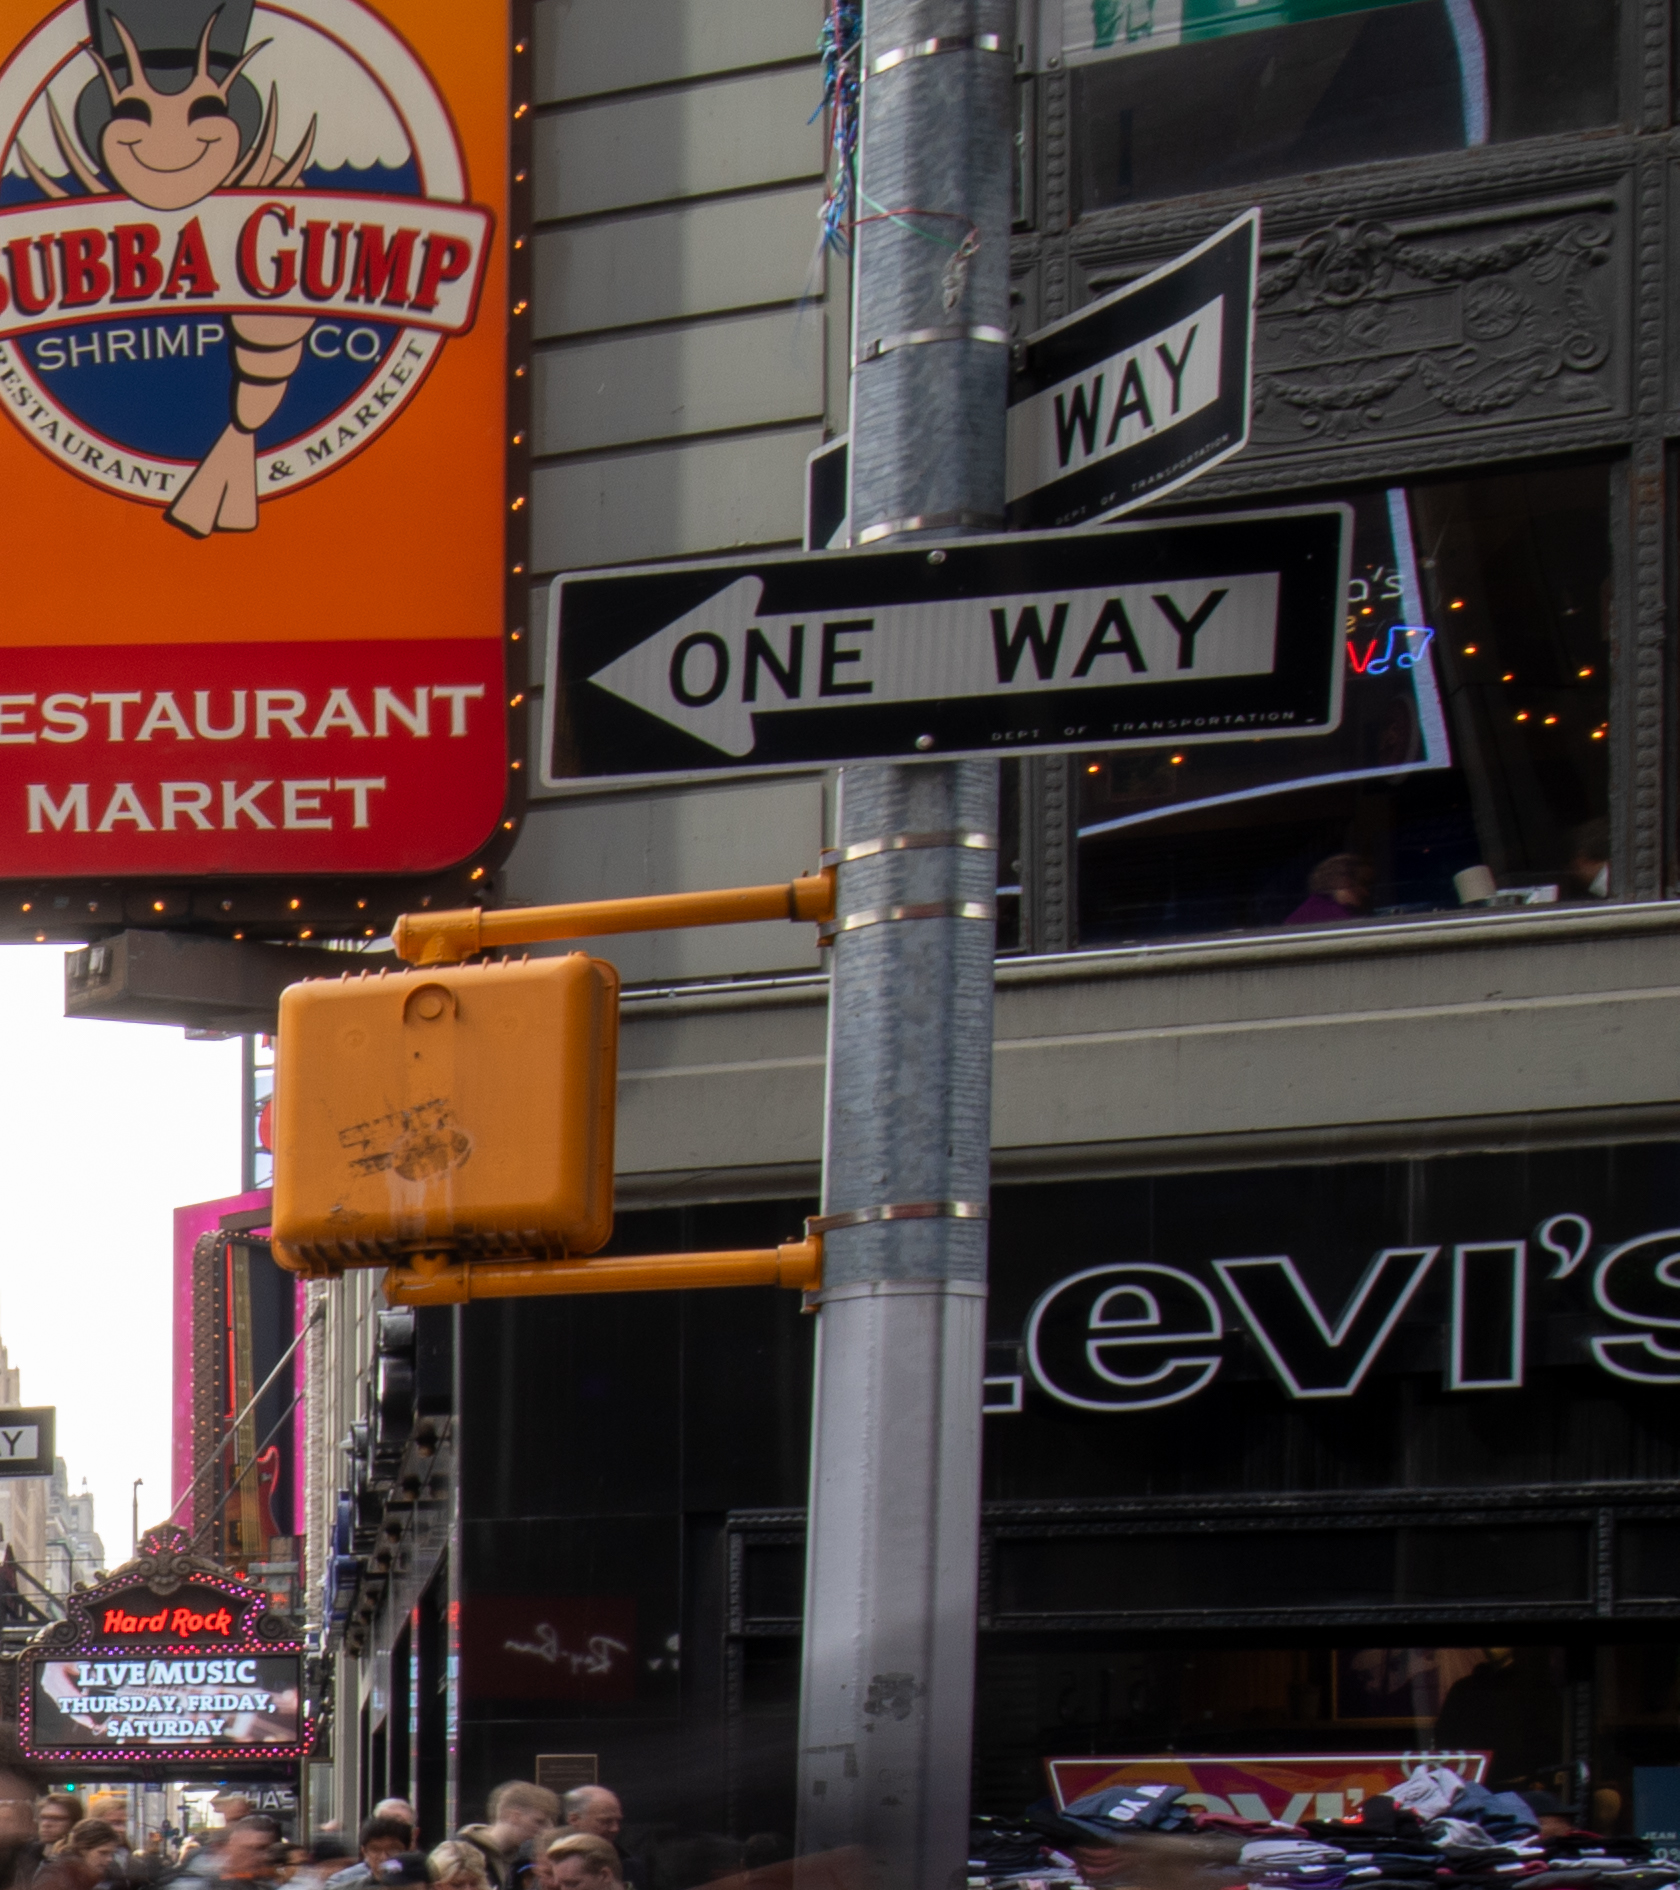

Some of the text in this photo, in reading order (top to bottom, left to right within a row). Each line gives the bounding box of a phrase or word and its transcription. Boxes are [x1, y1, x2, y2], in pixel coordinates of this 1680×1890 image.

[236, 202, 473, 315] GUMP
[35, 323, 383, 371] SHRIMP CO.
[268, 459, 295, 482] &
[304, 338, 425, 466] MARKET
[1053, 323, 1200, 468] WAY
[668, 588, 1229, 708] ONE WAY
[990, 711, 1295, 742] DEPT OF TRANSPORTATION
[25, 777, 387, 833] MARKET
[983, 1211, 1680, 1412] evi's
[103, 1607, 233, 1637] Hard Rock
[77, 1659, 257, 1686] LIVE MUSIC
[59, 1693, 276, 1715] THURSDAY, FRIDAY,
[107, 1719, 226, 1738] SATURDAY
